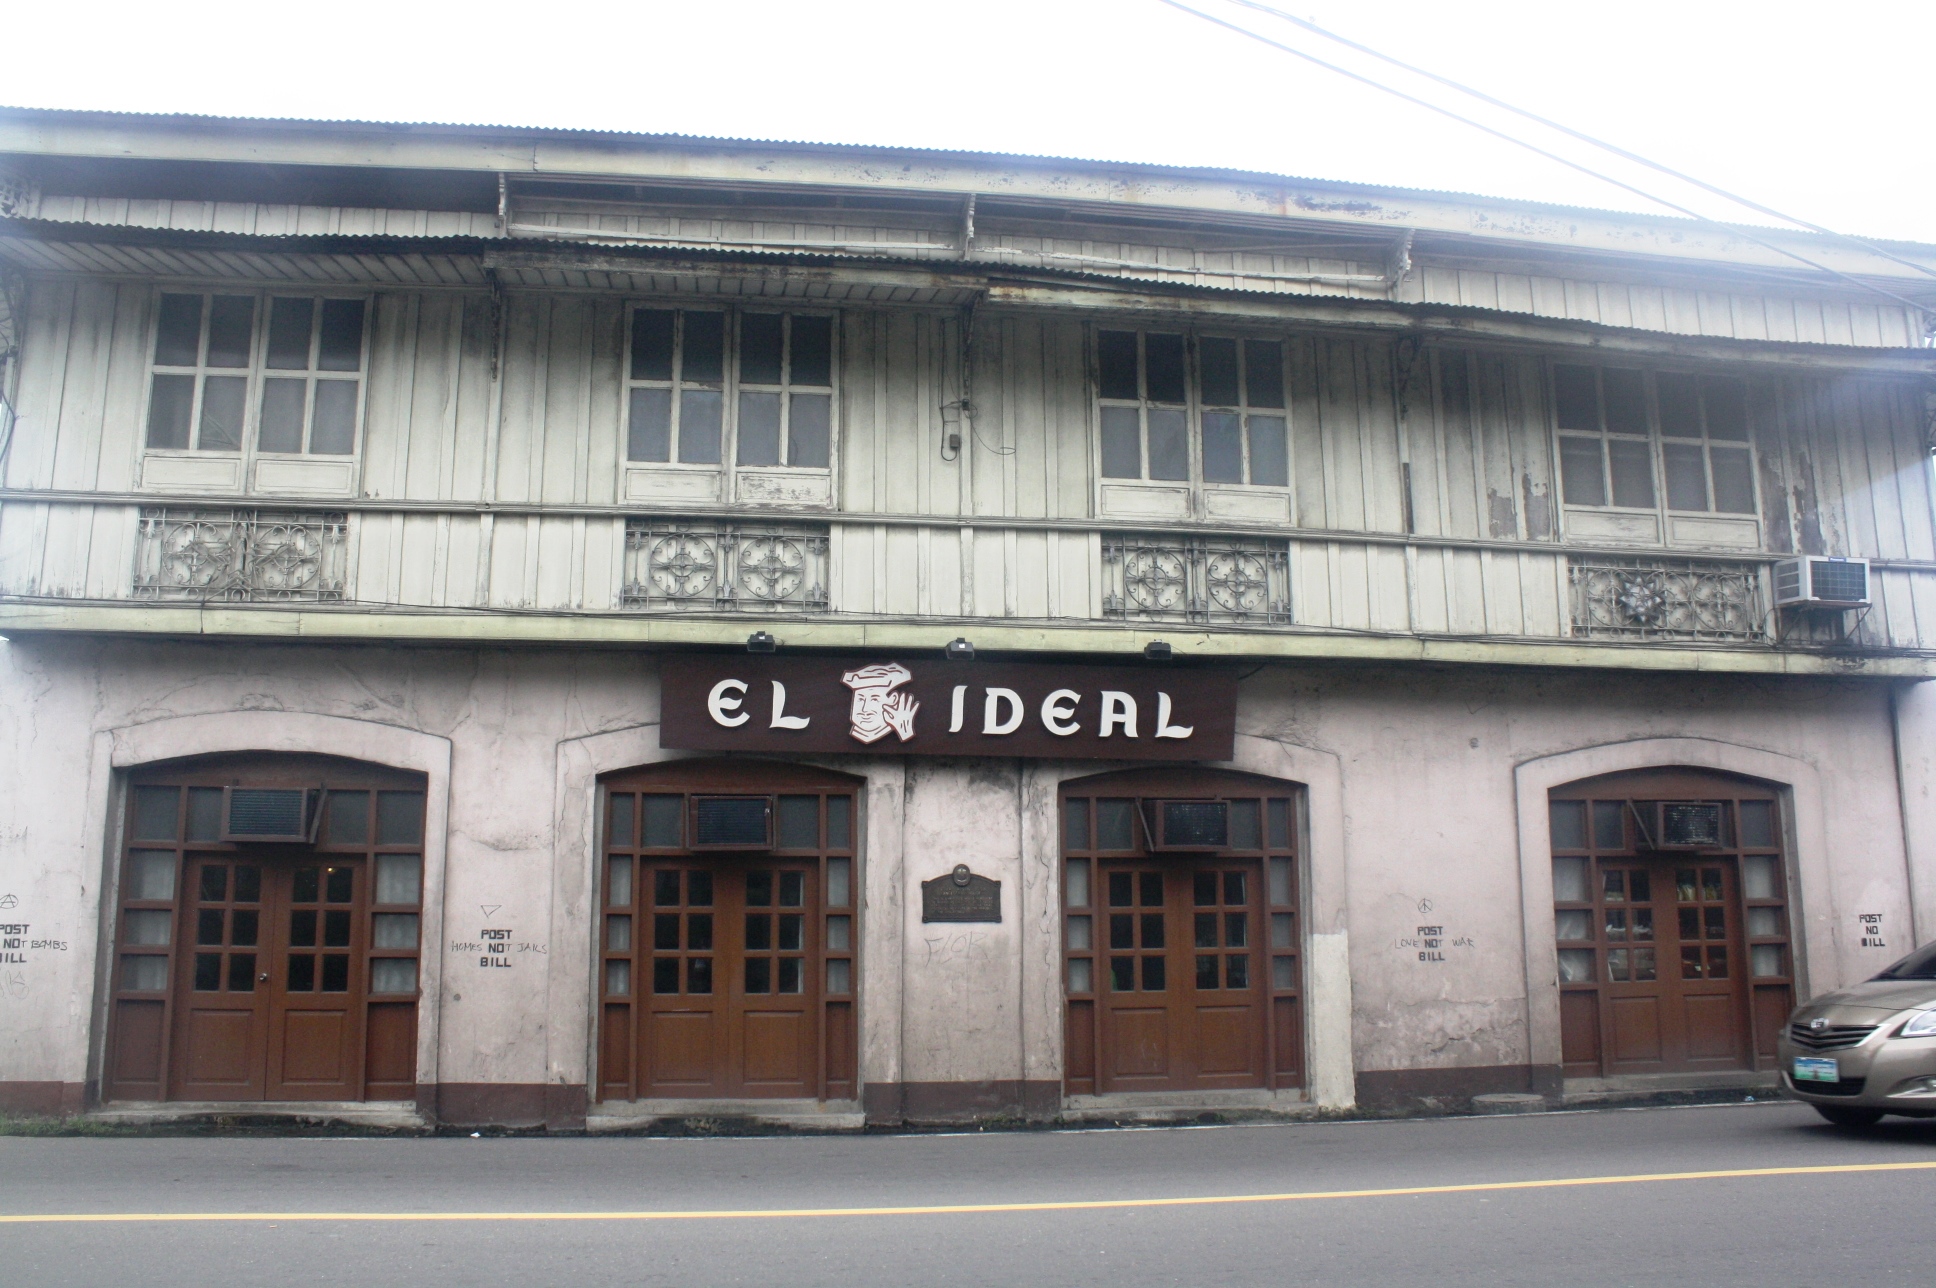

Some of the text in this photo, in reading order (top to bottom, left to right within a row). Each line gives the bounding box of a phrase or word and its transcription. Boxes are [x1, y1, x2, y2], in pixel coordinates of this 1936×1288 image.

[707, 678, 1194, 739] EL IDEAL
[1859, 913, 1883, 923] POST
[480, 929, 512, 940] POST
[1417, 926, 1443, 936] POST
[1865, 925, 1879, 935] NO
[451, 941, 482, 952] HOMES
[1394, 938, 1419, 949] LOVE
[1451, 937, 1475, 948] WAR
[479, 956, 511, 967] BILL
[1418, 951, 1446, 961] BILL
